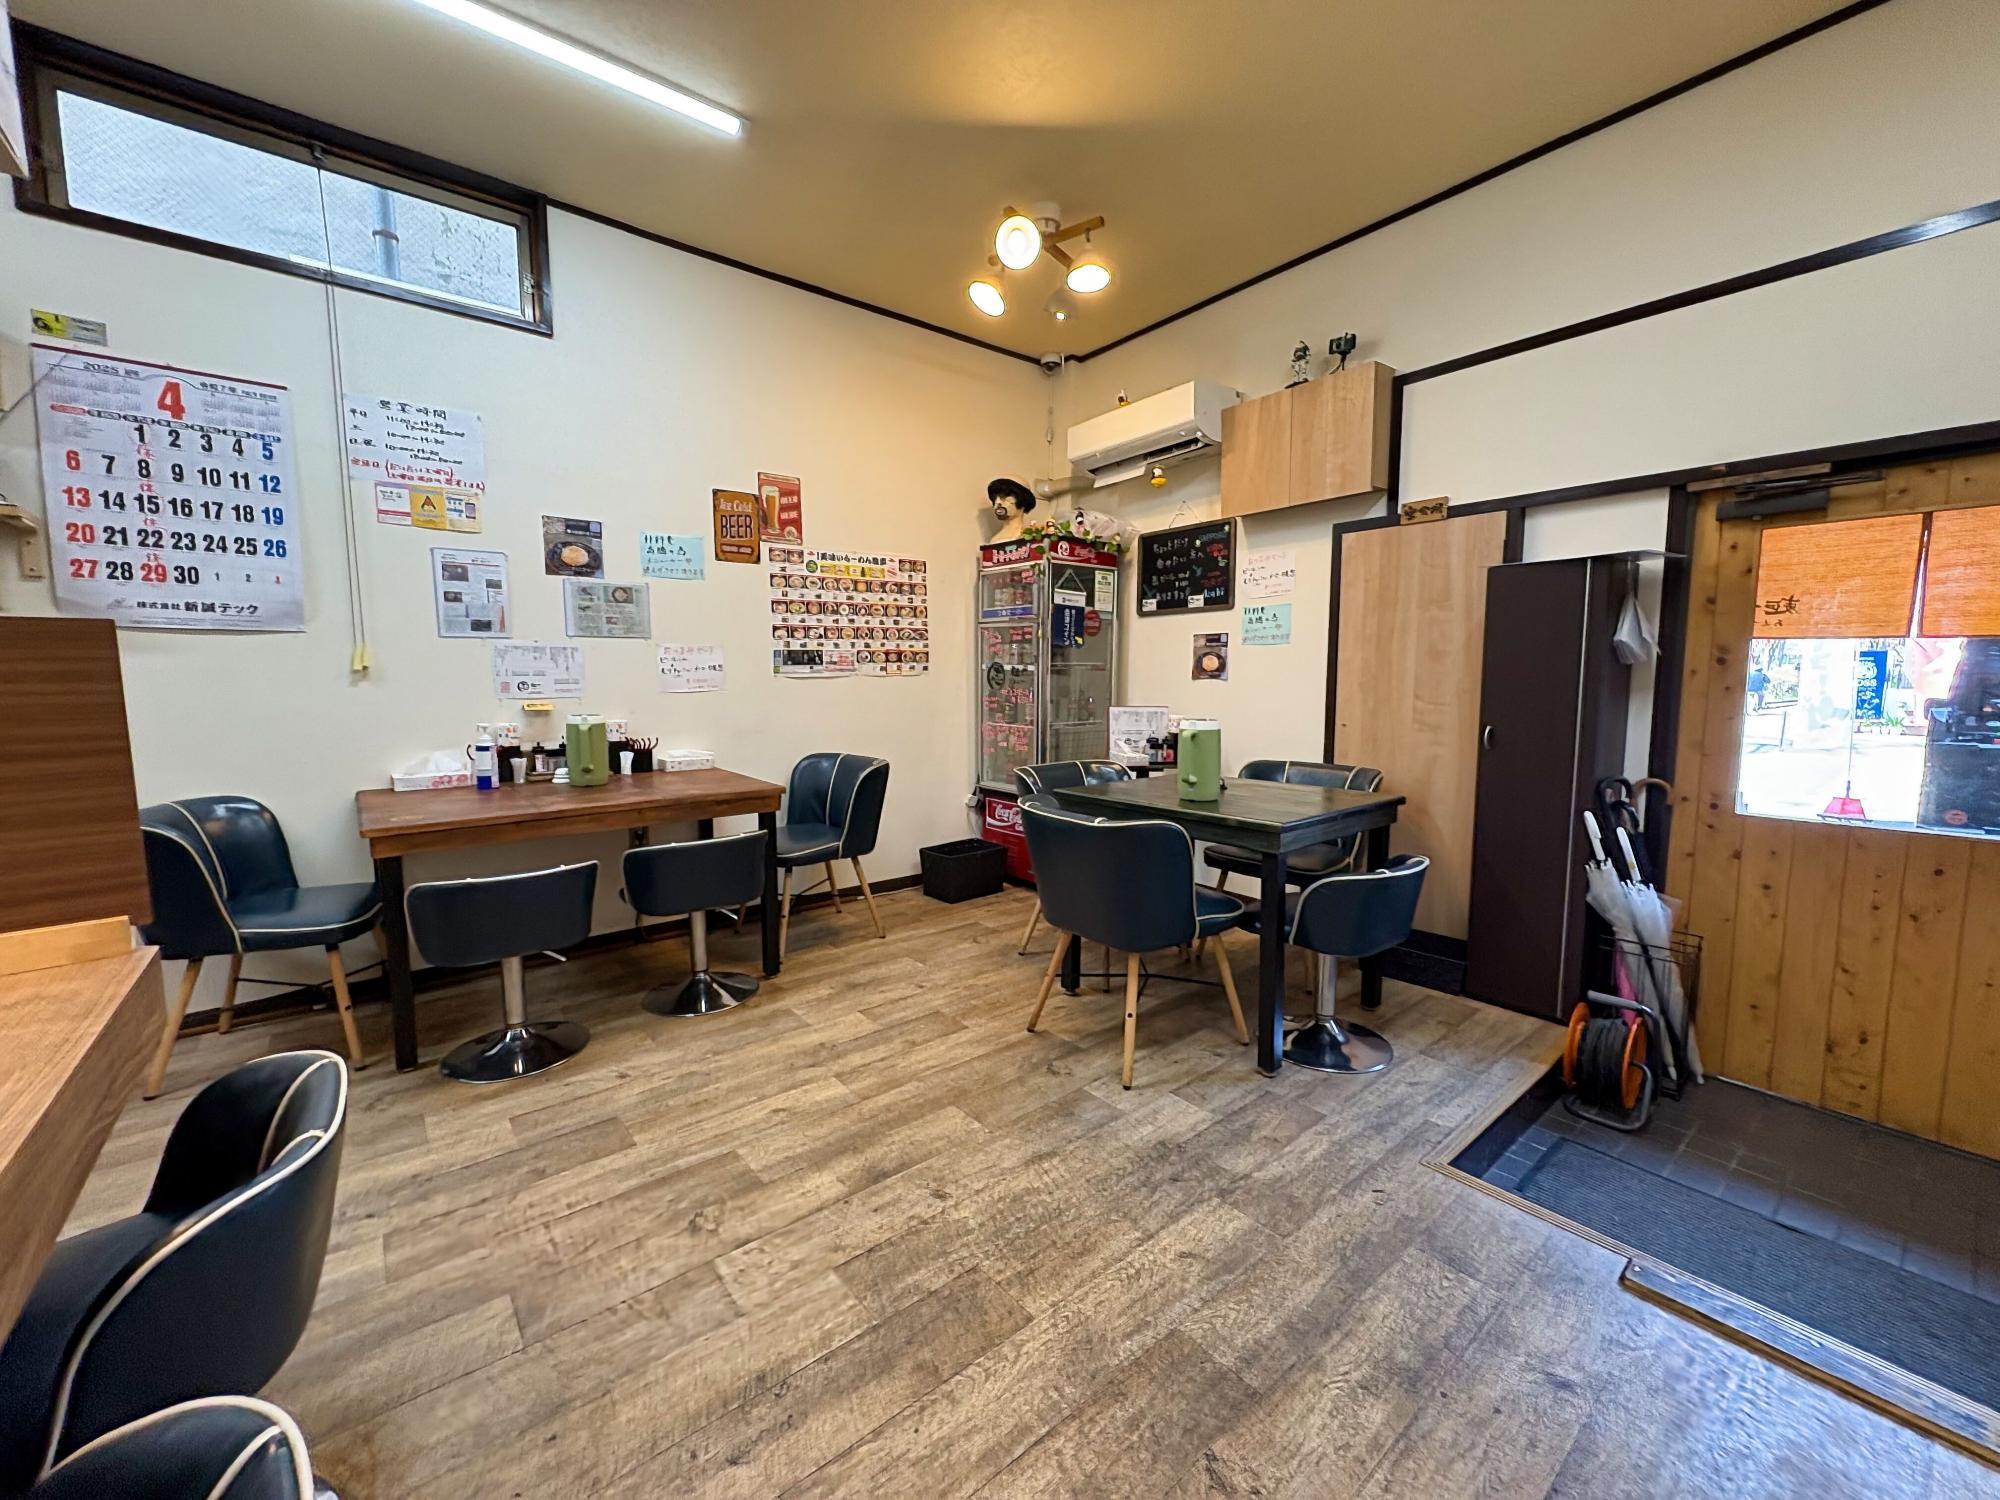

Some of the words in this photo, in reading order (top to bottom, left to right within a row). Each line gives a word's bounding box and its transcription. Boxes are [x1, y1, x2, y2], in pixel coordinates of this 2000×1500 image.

[158, 382, 186, 420] 4
[134, 425, 146, 444] 1
[168, 429, 181, 448] 2
[200, 434, 213, 452] 3
[233, 437, 246, 456] 4
[263, 441, 273, 460] 5
[67, 451, 80, 470] 6
[102, 455, 115, 474] 7
[138, 459, 151, 479] 8
[172, 464, 184, 482] 9
[197, 467, 221, 486] 10
[229, 471, 249, 490] 11
[259, 475, 281, 493] 12
[63, 487, 90, 507] 13
[99, 490, 125, 510] 14
[134, 494, 160, 514] 15
[168, 498, 193, 517] 16
[200, 501, 223, 520] 17
[232, 504, 254, 522] 18
[262, 507, 283, 525] 19
[66, 523, 94, 543] 20
[103, 526, 128, 546] 21
[137, 529, 164, 548] 22
[171, 532, 196, 551] 23
[203, 535, 228, 553] 24
[234, 537, 257, 555] 25
[264, 539, 286, 557] 26
[720, 514, 753, 539] BEER
[71, 559, 97, 577] 27
[106, 561, 133, 580] 28
[141, 564, 167, 582] 29
[174, 566, 199, 584] 30
